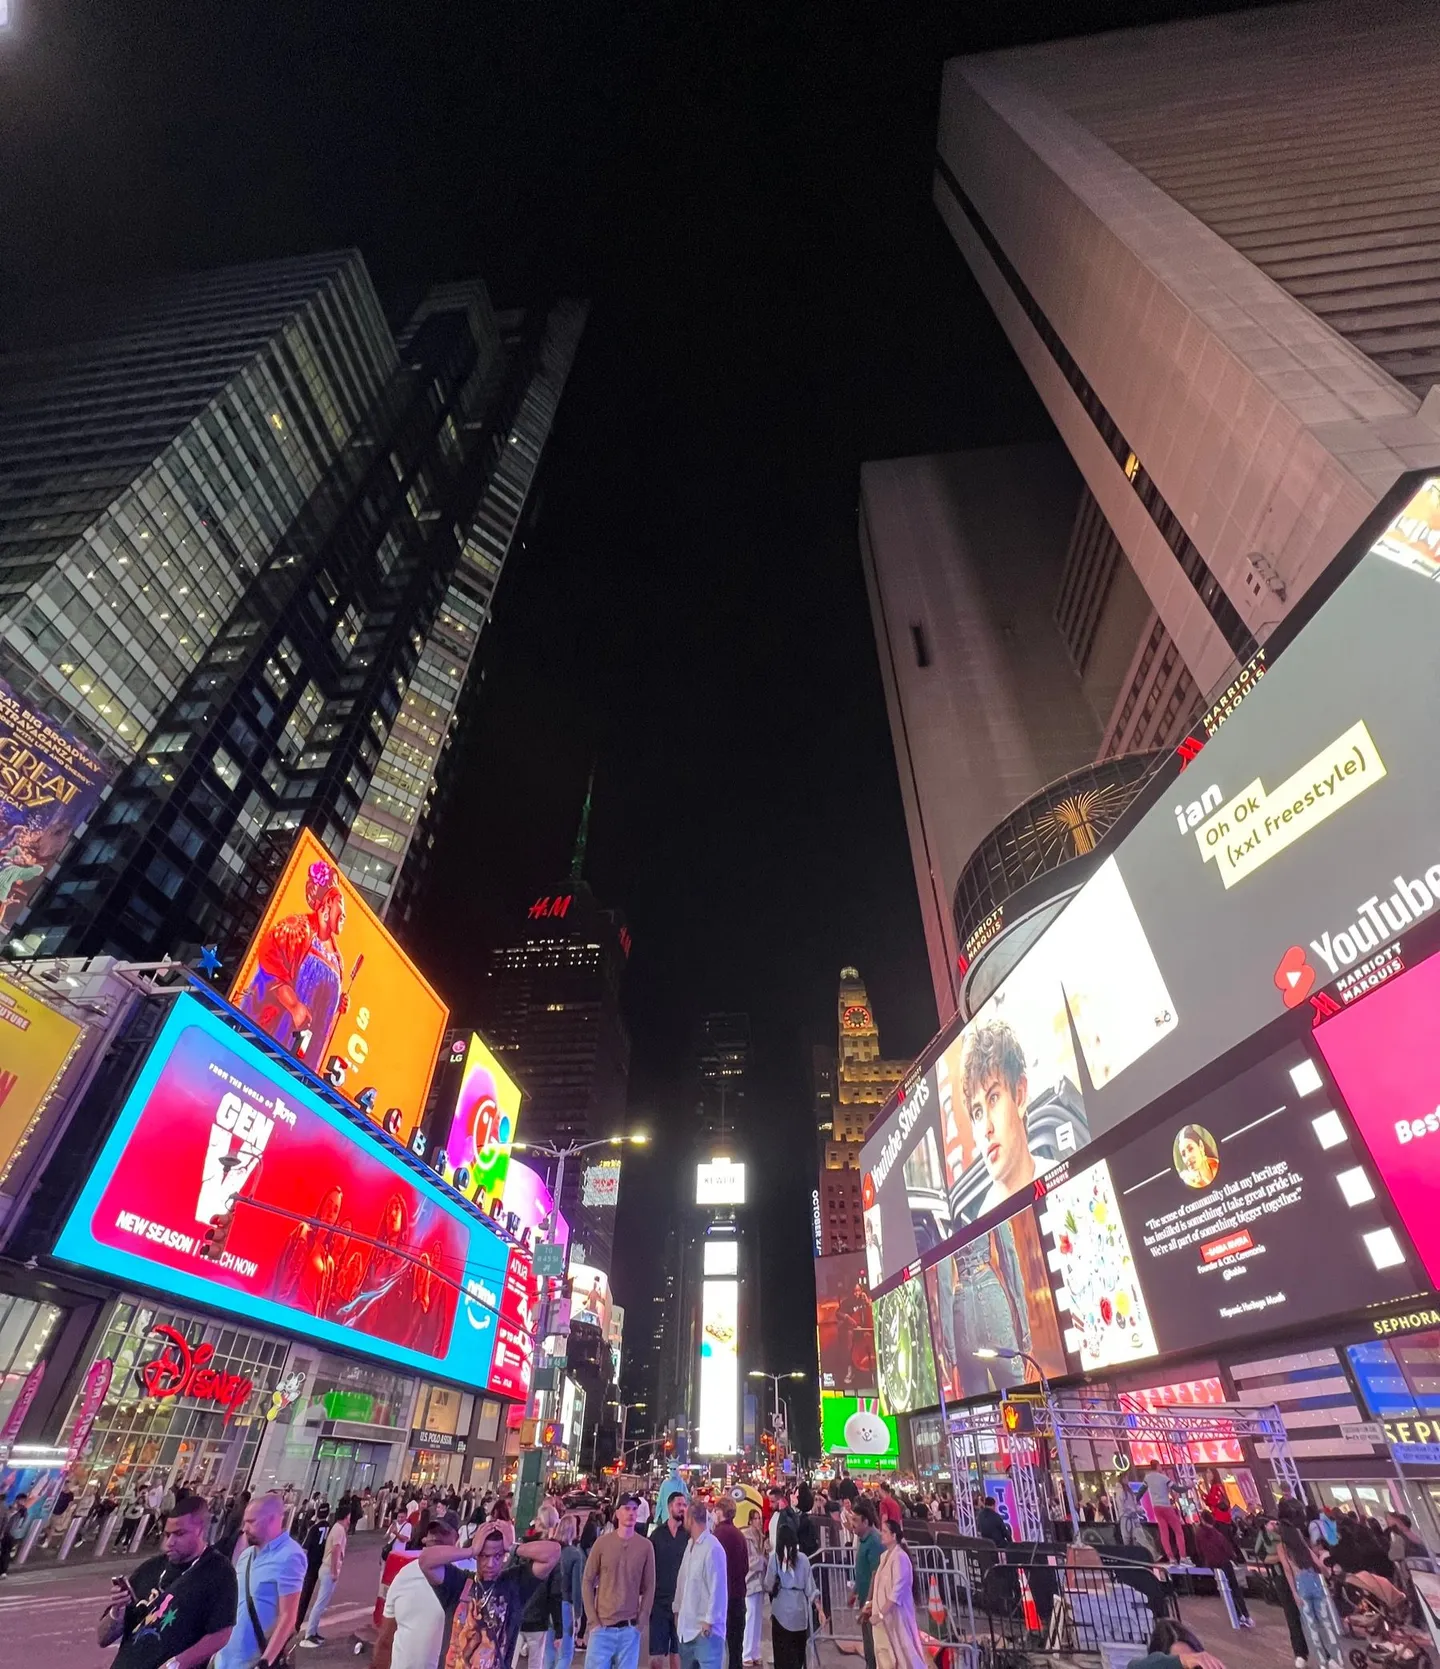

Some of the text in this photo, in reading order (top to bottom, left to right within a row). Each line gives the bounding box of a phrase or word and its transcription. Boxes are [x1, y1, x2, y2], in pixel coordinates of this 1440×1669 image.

[1203, 648, 1265, 727] MARRIOTT
[1208, 669, 1264, 737] MARQUIS
[15, 726, 34, 743] WITH
[34, 741, 50, 754] LIFE
[49, 752, 65, 765] AND
[22, 710, 42, 729] BIG
[43, 727, 101, 773] BROADWAY
[0, 737, 83, 805] GREAT
[1174, 783, 1224, 836] ian
[1205, 797, 1260, 846] Oh Ok
[528, 895, 572, 919] H&M
[966, 906, 1004, 951] MARRIOTT
[1310, 864, 1440, 974] YouTube
[968, 921, 1002, 961] MARQUIS
[1336, 942, 1402, 991] MARRIOTT
[1342, 959, 1402, 1002] MARQUIS
[450, 1053, 463, 1063] LG
[209, 1063, 229, 1080] FROM
[229, 1075, 243, 1089] THE
[243, 1084, 265, 1104] WORLD
[265, 1099, 274, 1109] OF
[216, 1091, 275, 1152] GEN
[870, 1077, 930, 1193] YouTube Shorts
[1044, 1161, 1069, 1182] MARRIOTT
[1046, 1172, 1069, 1191] MARQUIS
[1160, 1211, 1178, 1224] sense
[1177, 1204, 1186, 1217] of
[1185, 1190, 1223, 1213] community
[1222, 1181, 1241, 1196] that
[1240, 1175, 1253, 1189] my
[1252, 1161, 1288, 1183] heritage
[812, 1189, 821, 1237] OCTOBER
[1179, 1221, 1188, 1231] is
[1186, 1206, 1224, 1228] something
[1226, 1197, 1245, 1211] take
[1244, 1186, 1267, 1206] great
[1266, 1176, 1289, 1197] pride
[1288, 1173, 1303, 1185] in.
[115, 1210, 258, 1277] NEW SEASON NOW
[1168, 1238, 1178, 1251] all
[1177, 1233, 1193, 1249] part
[1192, 1228, 1200, 1241] of
[1199, 1216, 1239, 1238] something
[1236, 1206, 1262, 1223] bigger
[1374, 1310, 1440, 1335] SEPHORA
